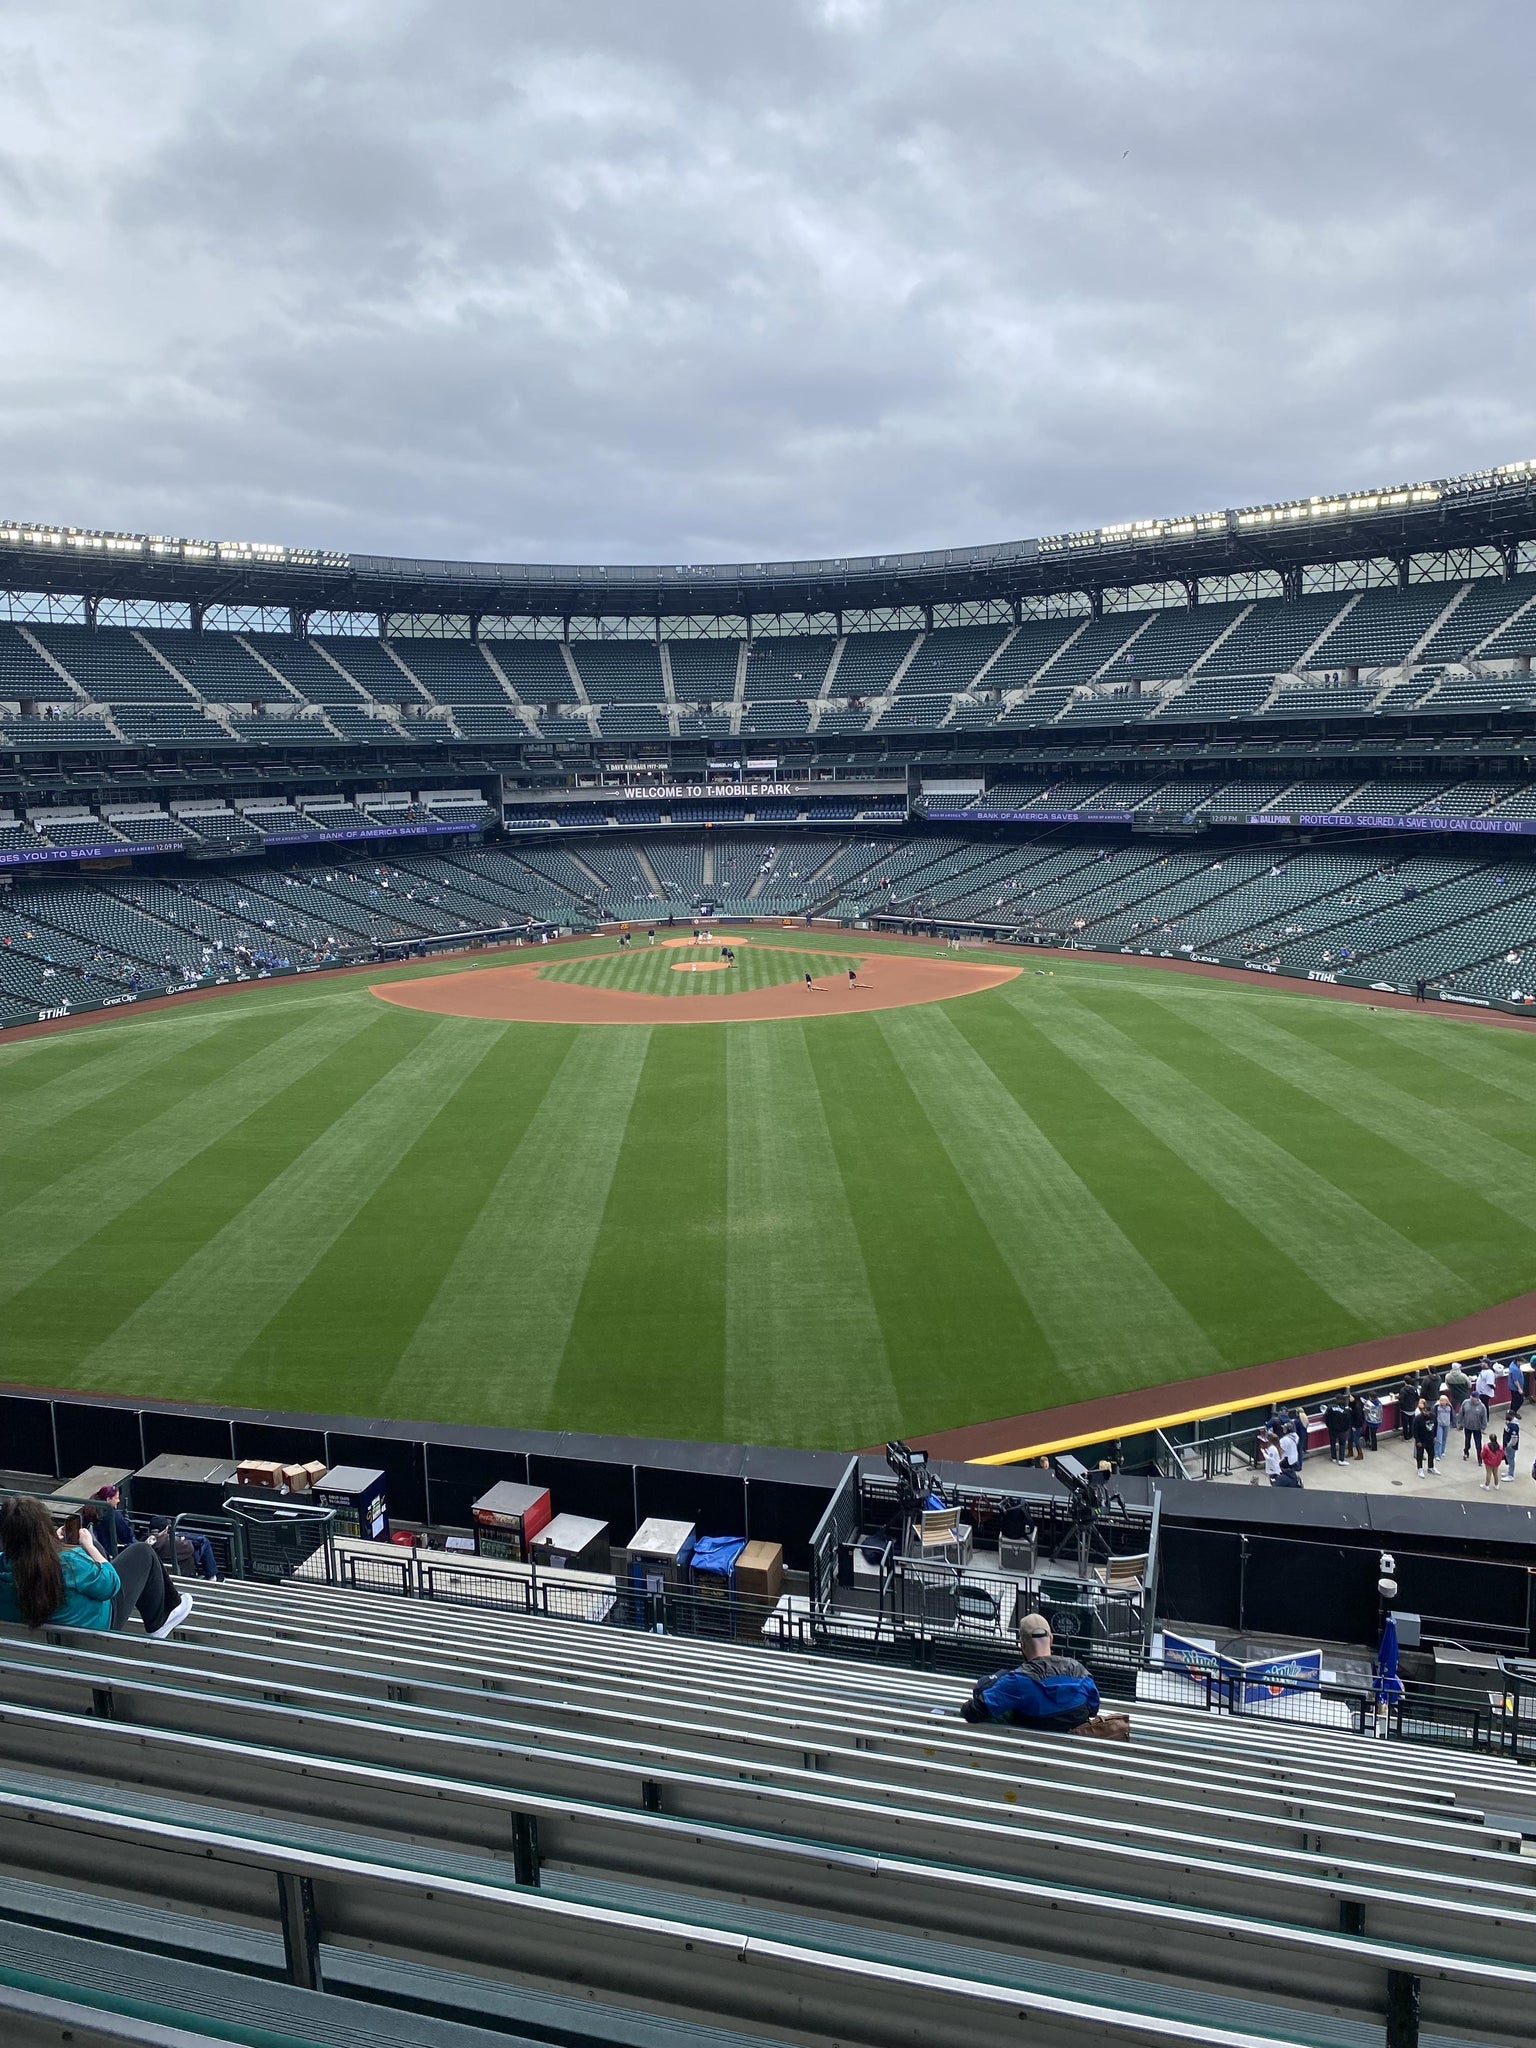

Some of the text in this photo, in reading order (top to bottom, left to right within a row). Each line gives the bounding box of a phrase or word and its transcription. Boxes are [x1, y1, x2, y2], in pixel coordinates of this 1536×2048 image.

[624, 783, 791, 798] WELCOME TO T-MOBILE PARK
[1260, 815, 1291, 823] BALLPARK
[1300, 815, 1522, 832] PROTECTED. SECURED. A SAVE YOU CAN COUNT ON!
[360, 828, 397, 837] AMERICA
[156, 843, 172, 851] 12:09
[23, 852, 48, 861] YOU
[52, 850, 68, 858] TO
[71, 848, 101, 857] SAVE
[1197, 956, 1220, 964] LEXUS
[1307, 971, 1337, 983] STIHL
[174, 982, 197, 992] LEXUS
[103, 993, 137, 1006] Great Clips
[38, 1006, 70, 1021] STIHL
